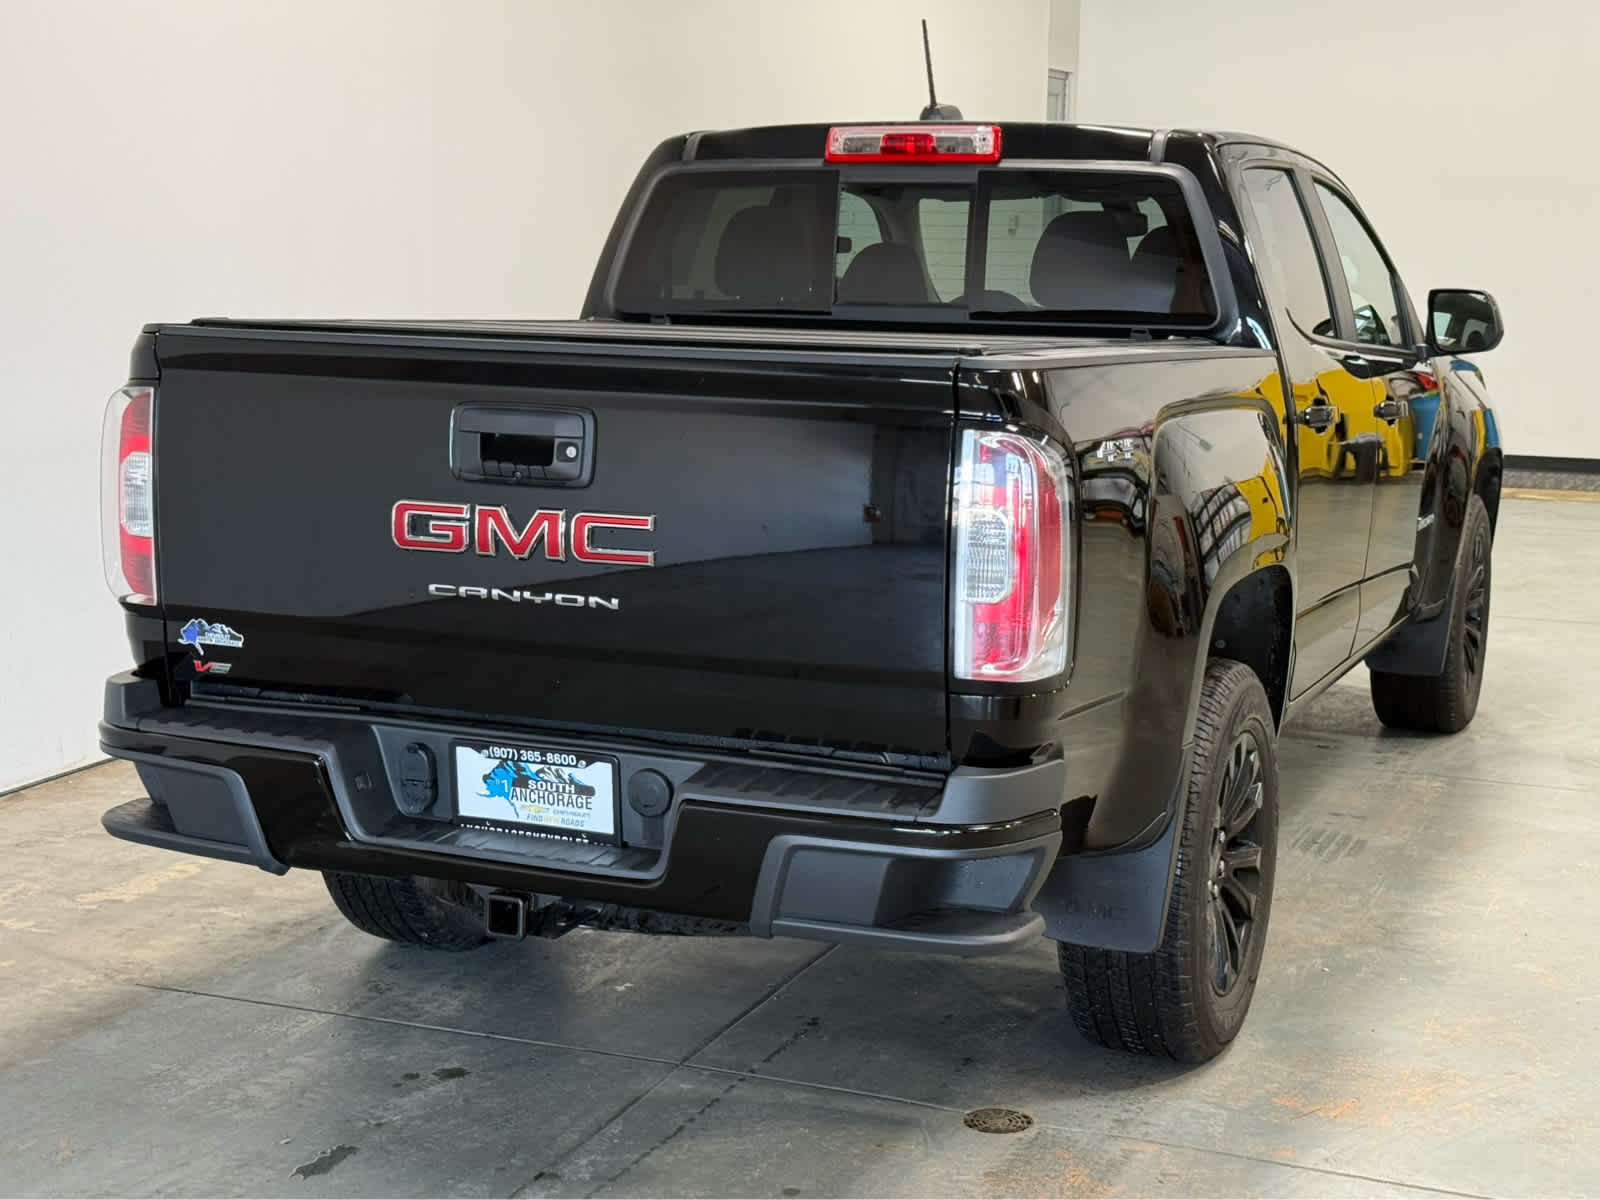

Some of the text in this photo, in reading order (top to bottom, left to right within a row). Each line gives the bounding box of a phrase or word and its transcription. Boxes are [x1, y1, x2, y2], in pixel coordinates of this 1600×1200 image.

[391, 499, 656, 567] GMC
[428, 583, 620, 610] CANYON
[489, 746, 577, 766] (907) 365-8600
[510, 787, 593, 810] ANCHORAGE
[528, 779, 575, 795] SOUTH
